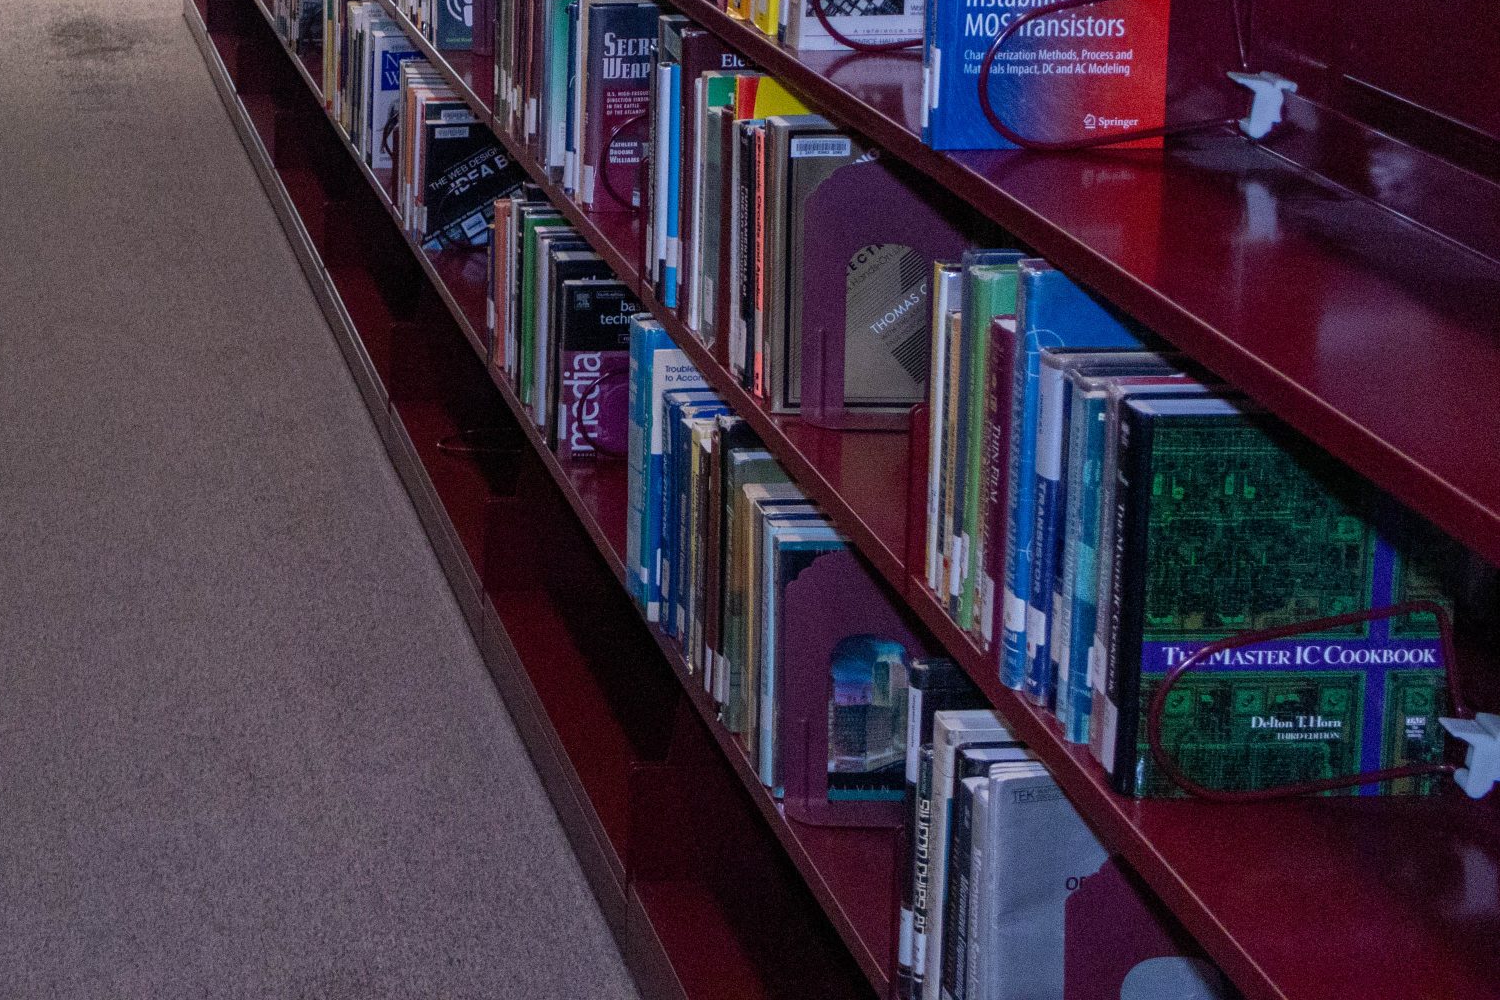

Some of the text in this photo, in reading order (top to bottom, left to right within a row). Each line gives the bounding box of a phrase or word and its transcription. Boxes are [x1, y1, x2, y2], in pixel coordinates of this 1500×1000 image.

[1015, 12, 1125, 38] Transistors
[1038, 49, 1133, 62] Methods, Process and
[1007, 63, 1131, 77] Impact, DC and AC Modeling
[1098, 116, 1139, 128] Springer
[429, 176, 447, 191] THE
[869, 293, 920, 335] THOMAS
[563, 351, 603, 452] media
[1034, 481, 1047, 595] TRANSISTOR
[1213, 648, 1290, 666] MASTER
[1295, 645, 1321, 666] IC
[1323, 645, 1437, 665] COOKBOOK
[1251, 715, 1293, 729] Delton
[1308, 716, 1342, 729] Horn
